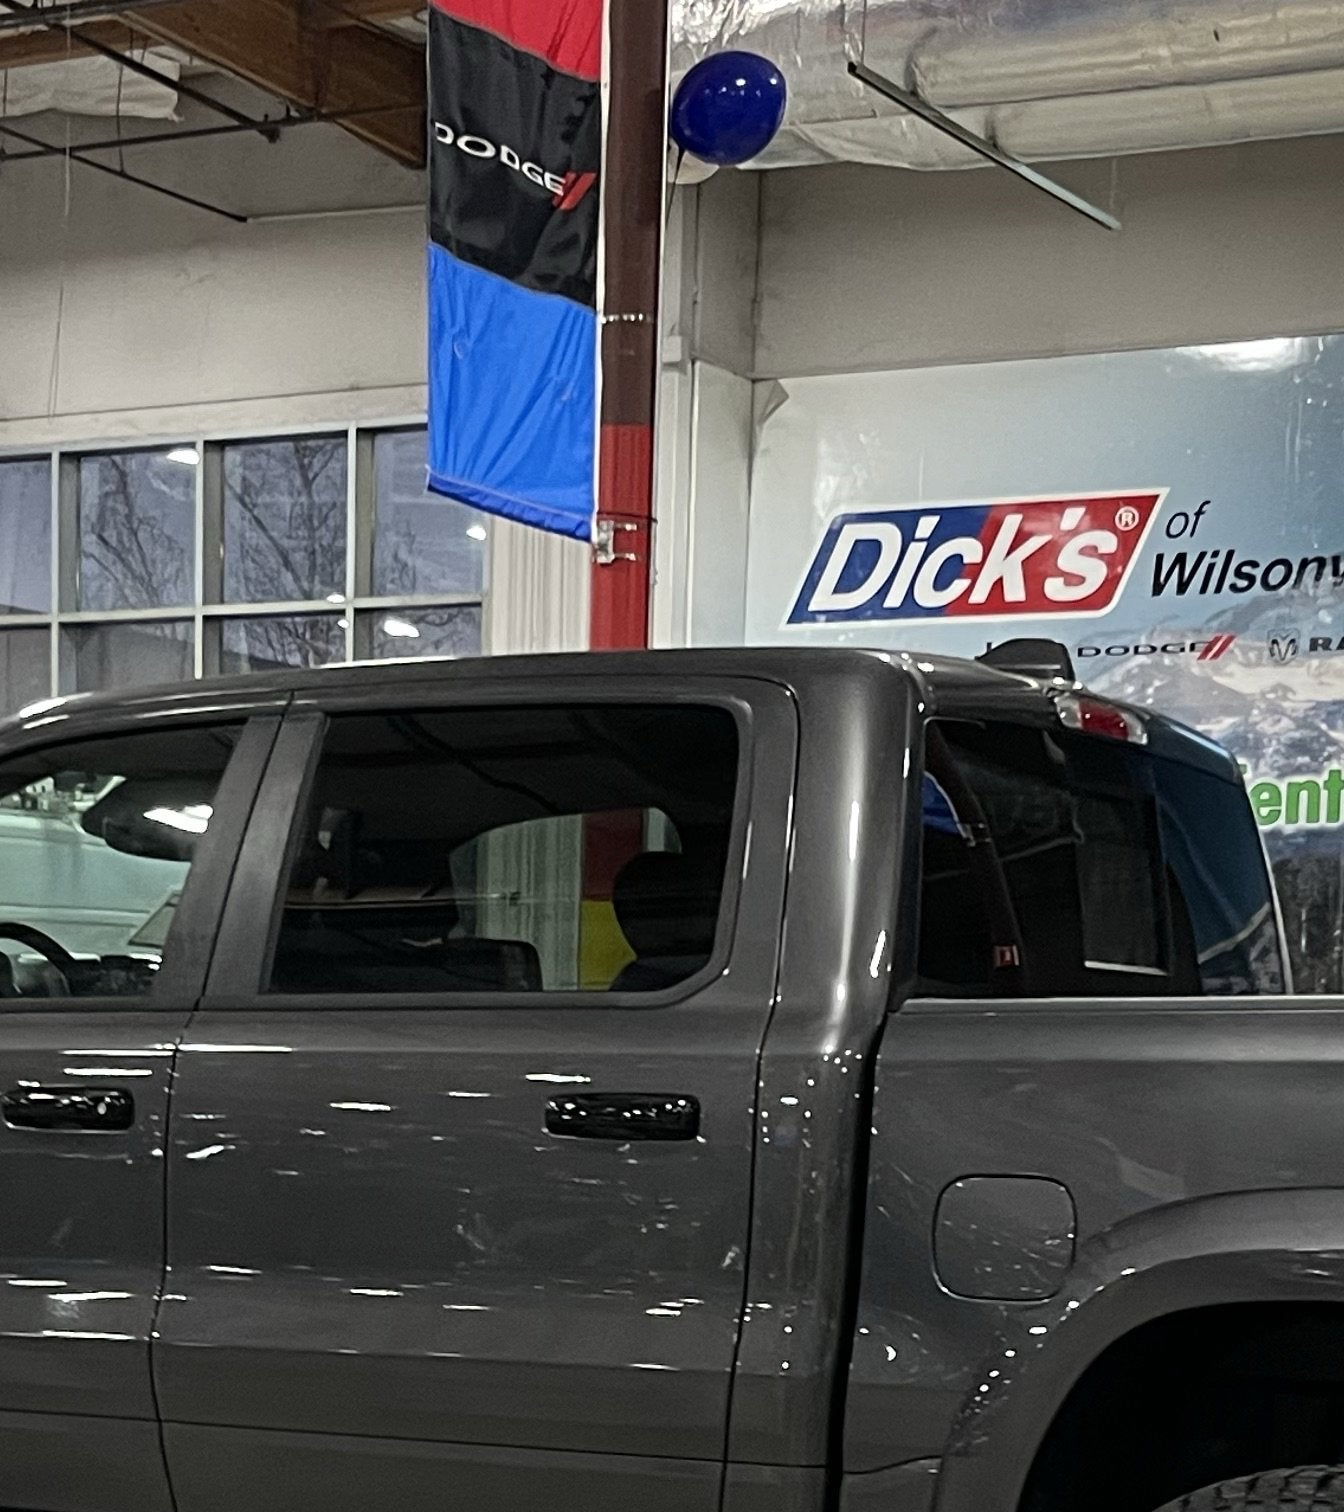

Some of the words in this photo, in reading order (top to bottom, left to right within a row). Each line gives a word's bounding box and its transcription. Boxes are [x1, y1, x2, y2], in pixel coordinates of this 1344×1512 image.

[435, 121, 566, 197] DODGE
[807, 507, 1119, 613] Dick's
[1164, 500, 1211, 540] of
